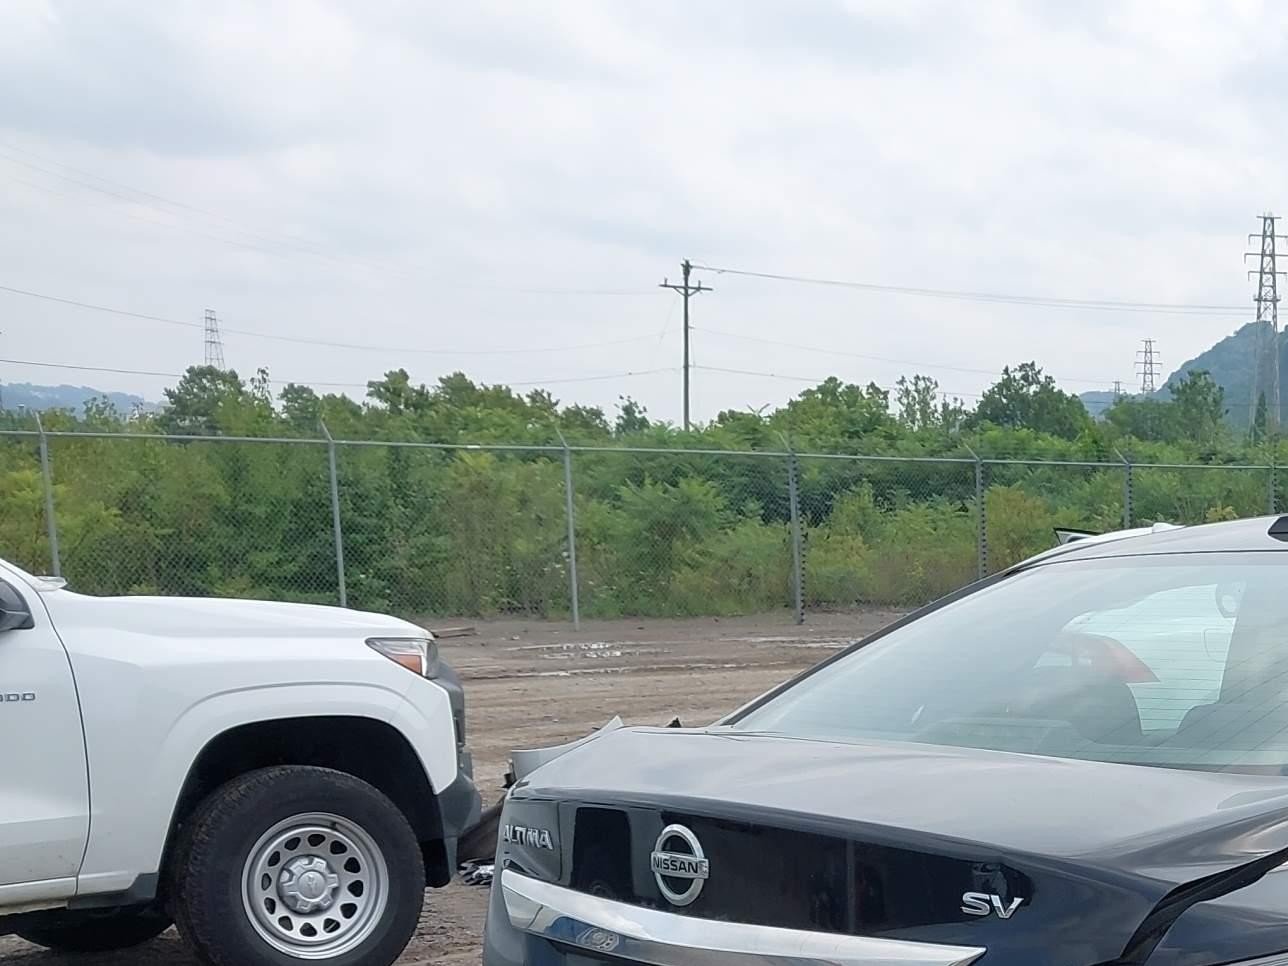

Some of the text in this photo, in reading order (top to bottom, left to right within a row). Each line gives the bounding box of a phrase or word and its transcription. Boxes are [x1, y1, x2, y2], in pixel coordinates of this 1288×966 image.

[503, 824, 553, 850] ALTIMA
[653, 855, 699, 874] NISSAN
[960, 891, 1025, 919] SV
